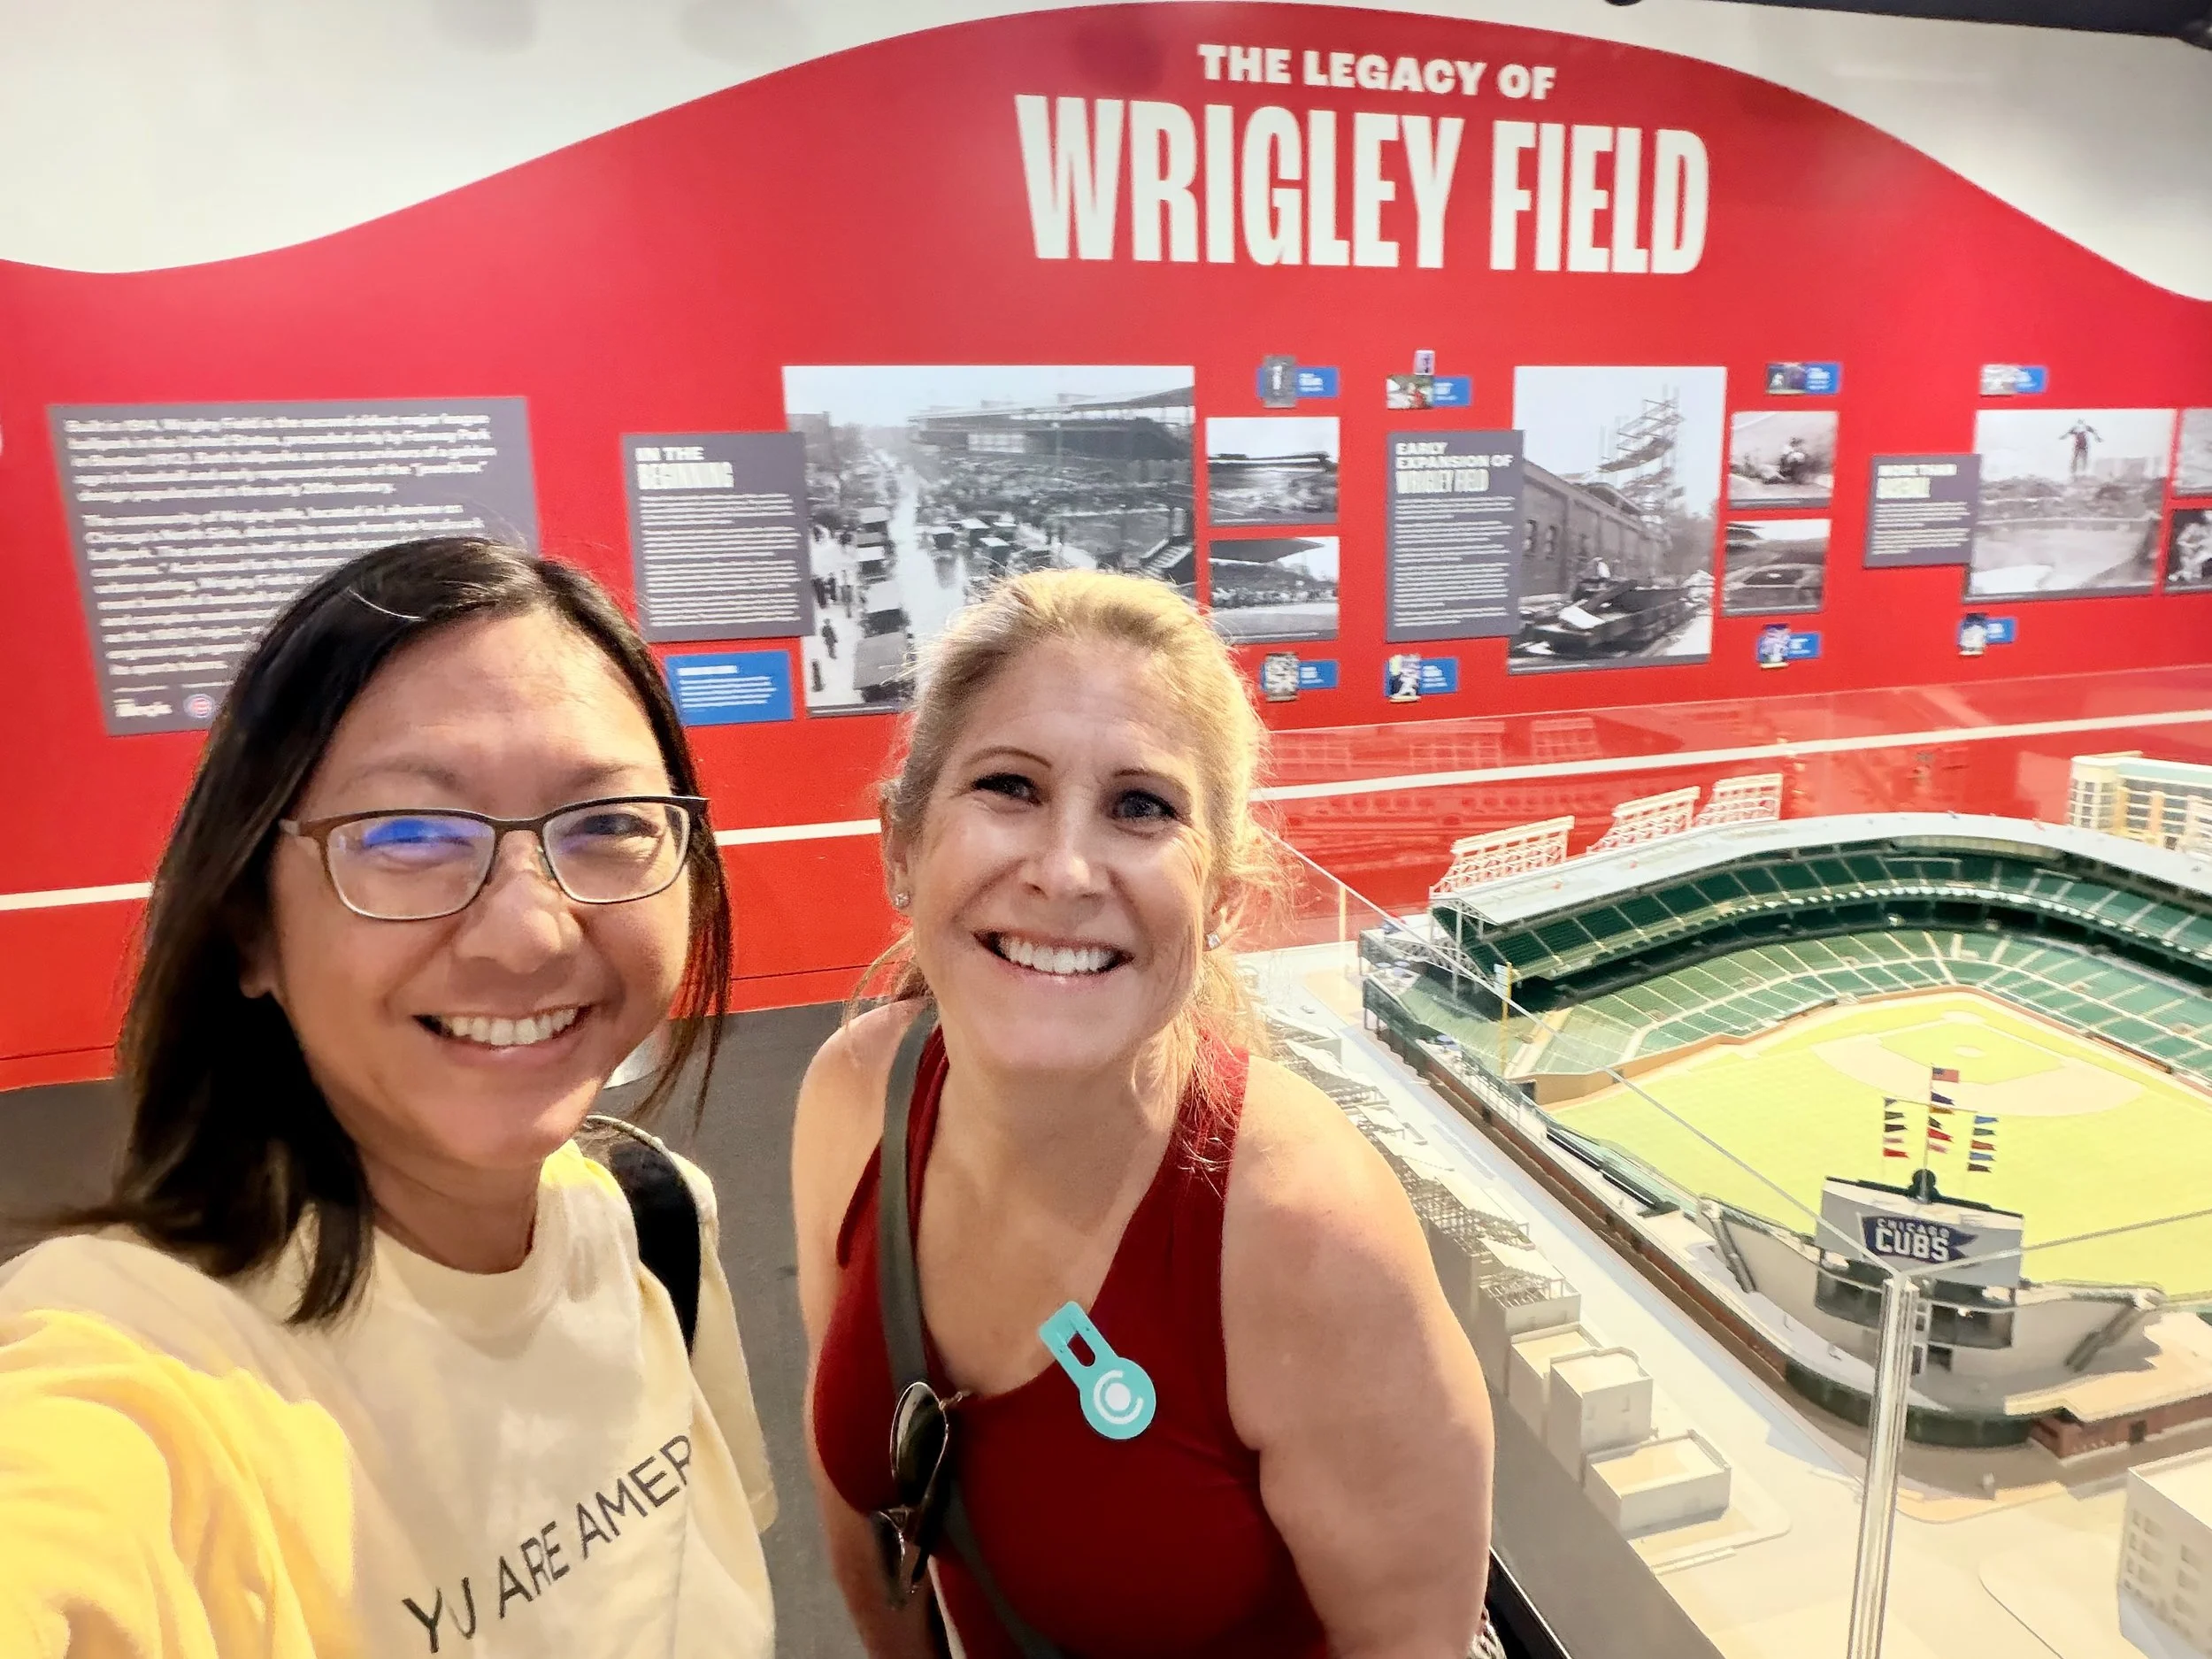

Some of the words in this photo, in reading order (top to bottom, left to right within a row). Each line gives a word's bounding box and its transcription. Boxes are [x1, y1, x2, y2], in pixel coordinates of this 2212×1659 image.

[1197, 43, 1291, 84] THE
[1303, 50, 1487, 96] LEGACY
[1498, 63, 1556, 100] OF
[1015, 94, 1464, 269] WRIGLEY
[1489, 119, 1709, 274] FIELD
[662, 446, 705, 461] THE
[1490, 454, 1515, 468] OF
[1875, 1226, 1950, 1262] CUBS
[1876, 1217, 1950, 1238] CHICAGO
[496, 1520, 571, 1619] ARE
